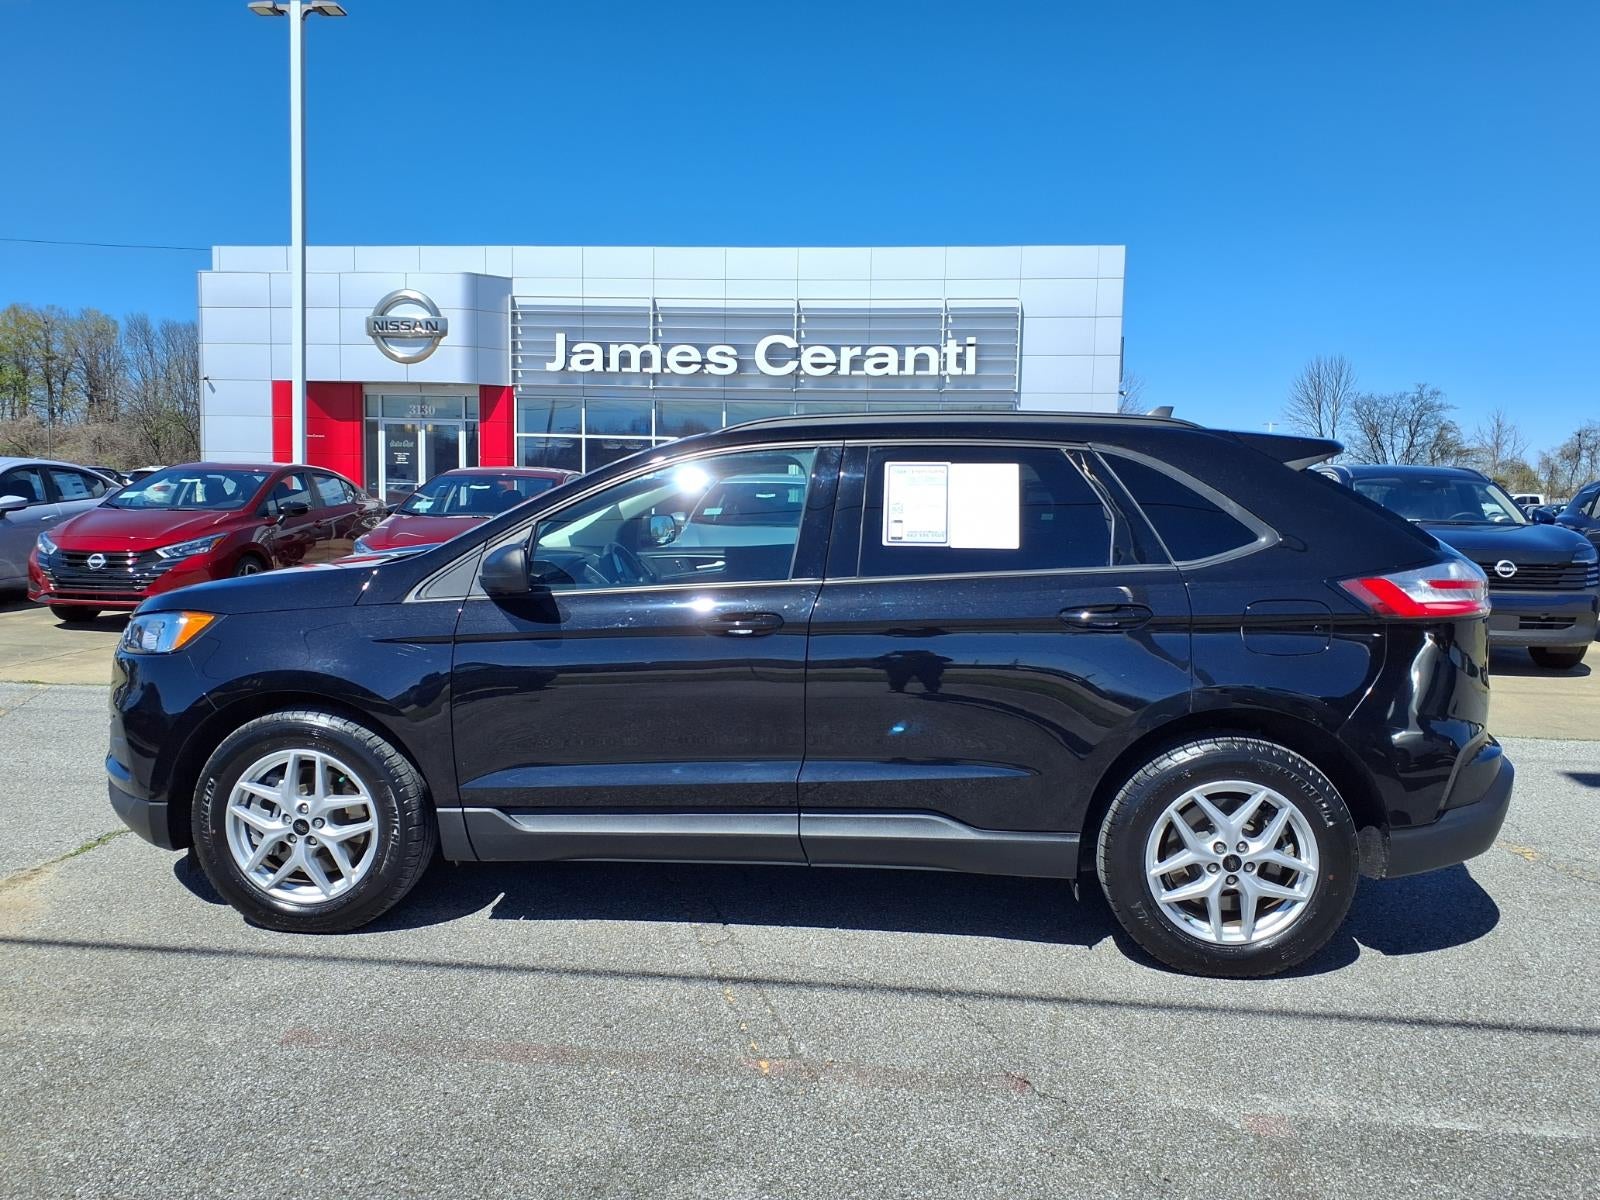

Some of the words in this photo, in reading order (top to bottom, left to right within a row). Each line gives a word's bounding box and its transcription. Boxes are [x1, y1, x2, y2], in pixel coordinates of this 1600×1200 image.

[373, 320, 439, 333] NISSAN
[545, 332, 738, 375] James
[754, 334, 977, 376] Ceranti
[409, 404, 436, 416] 3130
